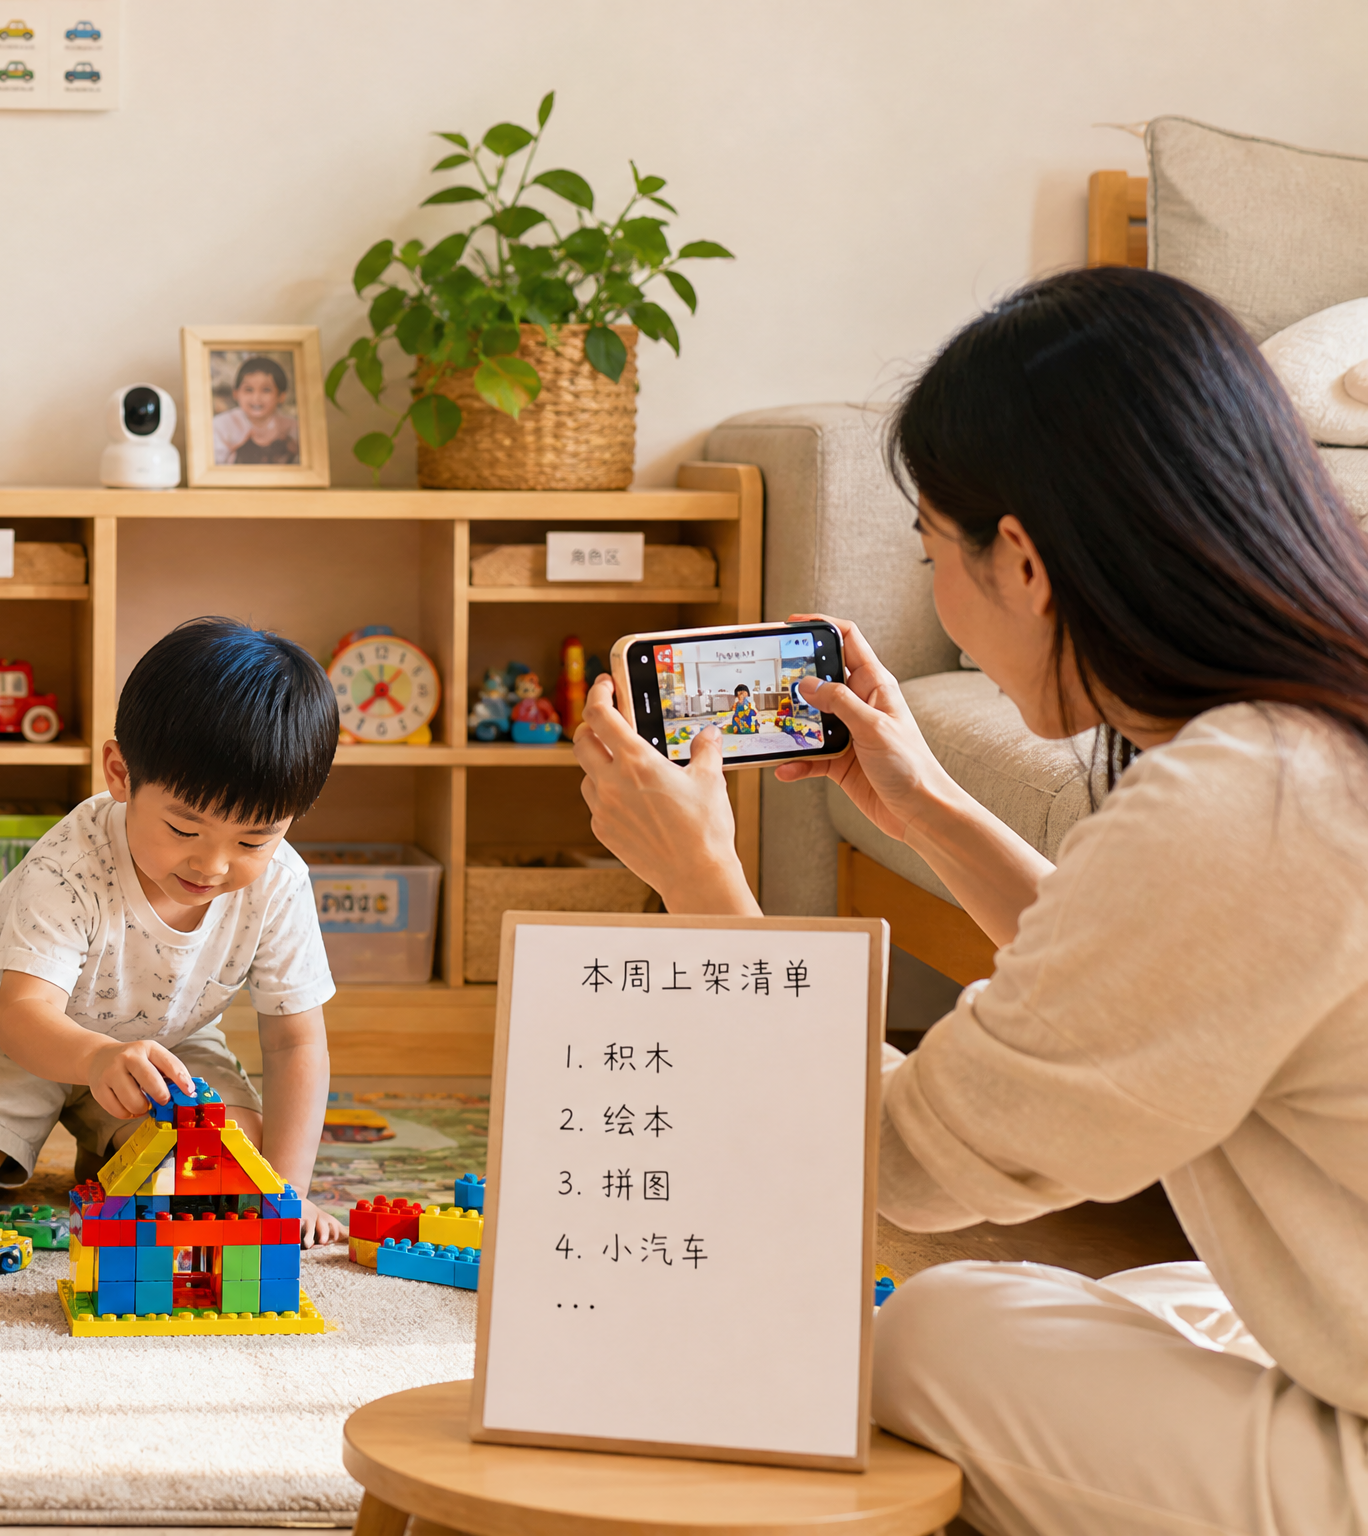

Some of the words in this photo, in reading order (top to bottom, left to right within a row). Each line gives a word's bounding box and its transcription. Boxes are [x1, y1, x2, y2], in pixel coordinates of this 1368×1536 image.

[570, 548, 620, 566] 角色区
[581, 957, 811, 998] 本周上架清单
[566, 1044, 583, 1069] 1.
[603, 1041, 673, 1074] 积木
[559, 1107, 584, 1132] 2.
[603, 1103, 673, 1138] 绘本
[558, 1170, 582, 1196] 3.
[601, 1167, 670, 1202] 拼图
[555, 1233, 582, 1260] 4.
[602, 1232, 709, 1270] 小汽车
